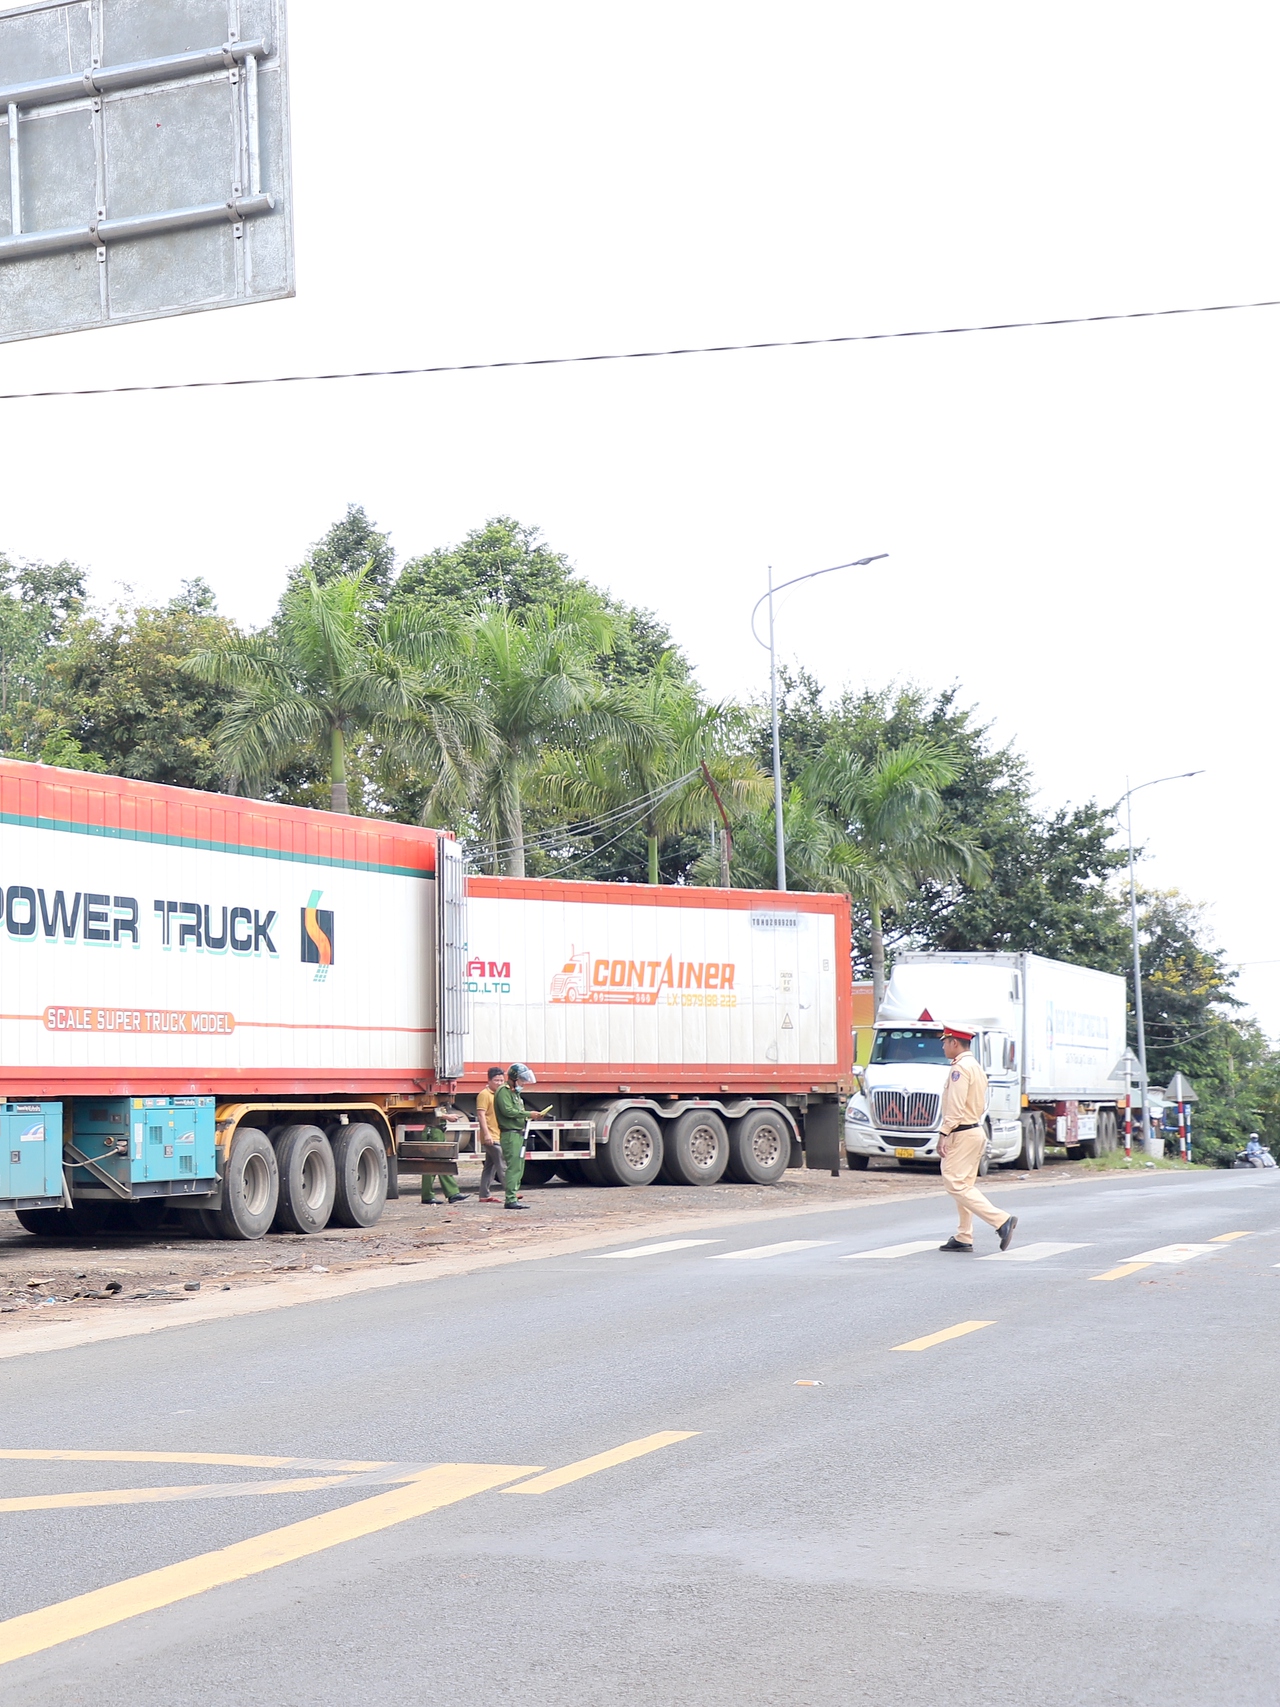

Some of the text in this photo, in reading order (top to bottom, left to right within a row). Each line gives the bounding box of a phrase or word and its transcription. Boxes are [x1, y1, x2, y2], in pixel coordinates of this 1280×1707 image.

[154, 899, 279, 959] TRUCK
[462, 956, 511, 978] ÂM
[593, 953, 735, 991] CONTAINER
[47, 1008, 232, 1033] SCALE SUPER TRUCK MODEL
